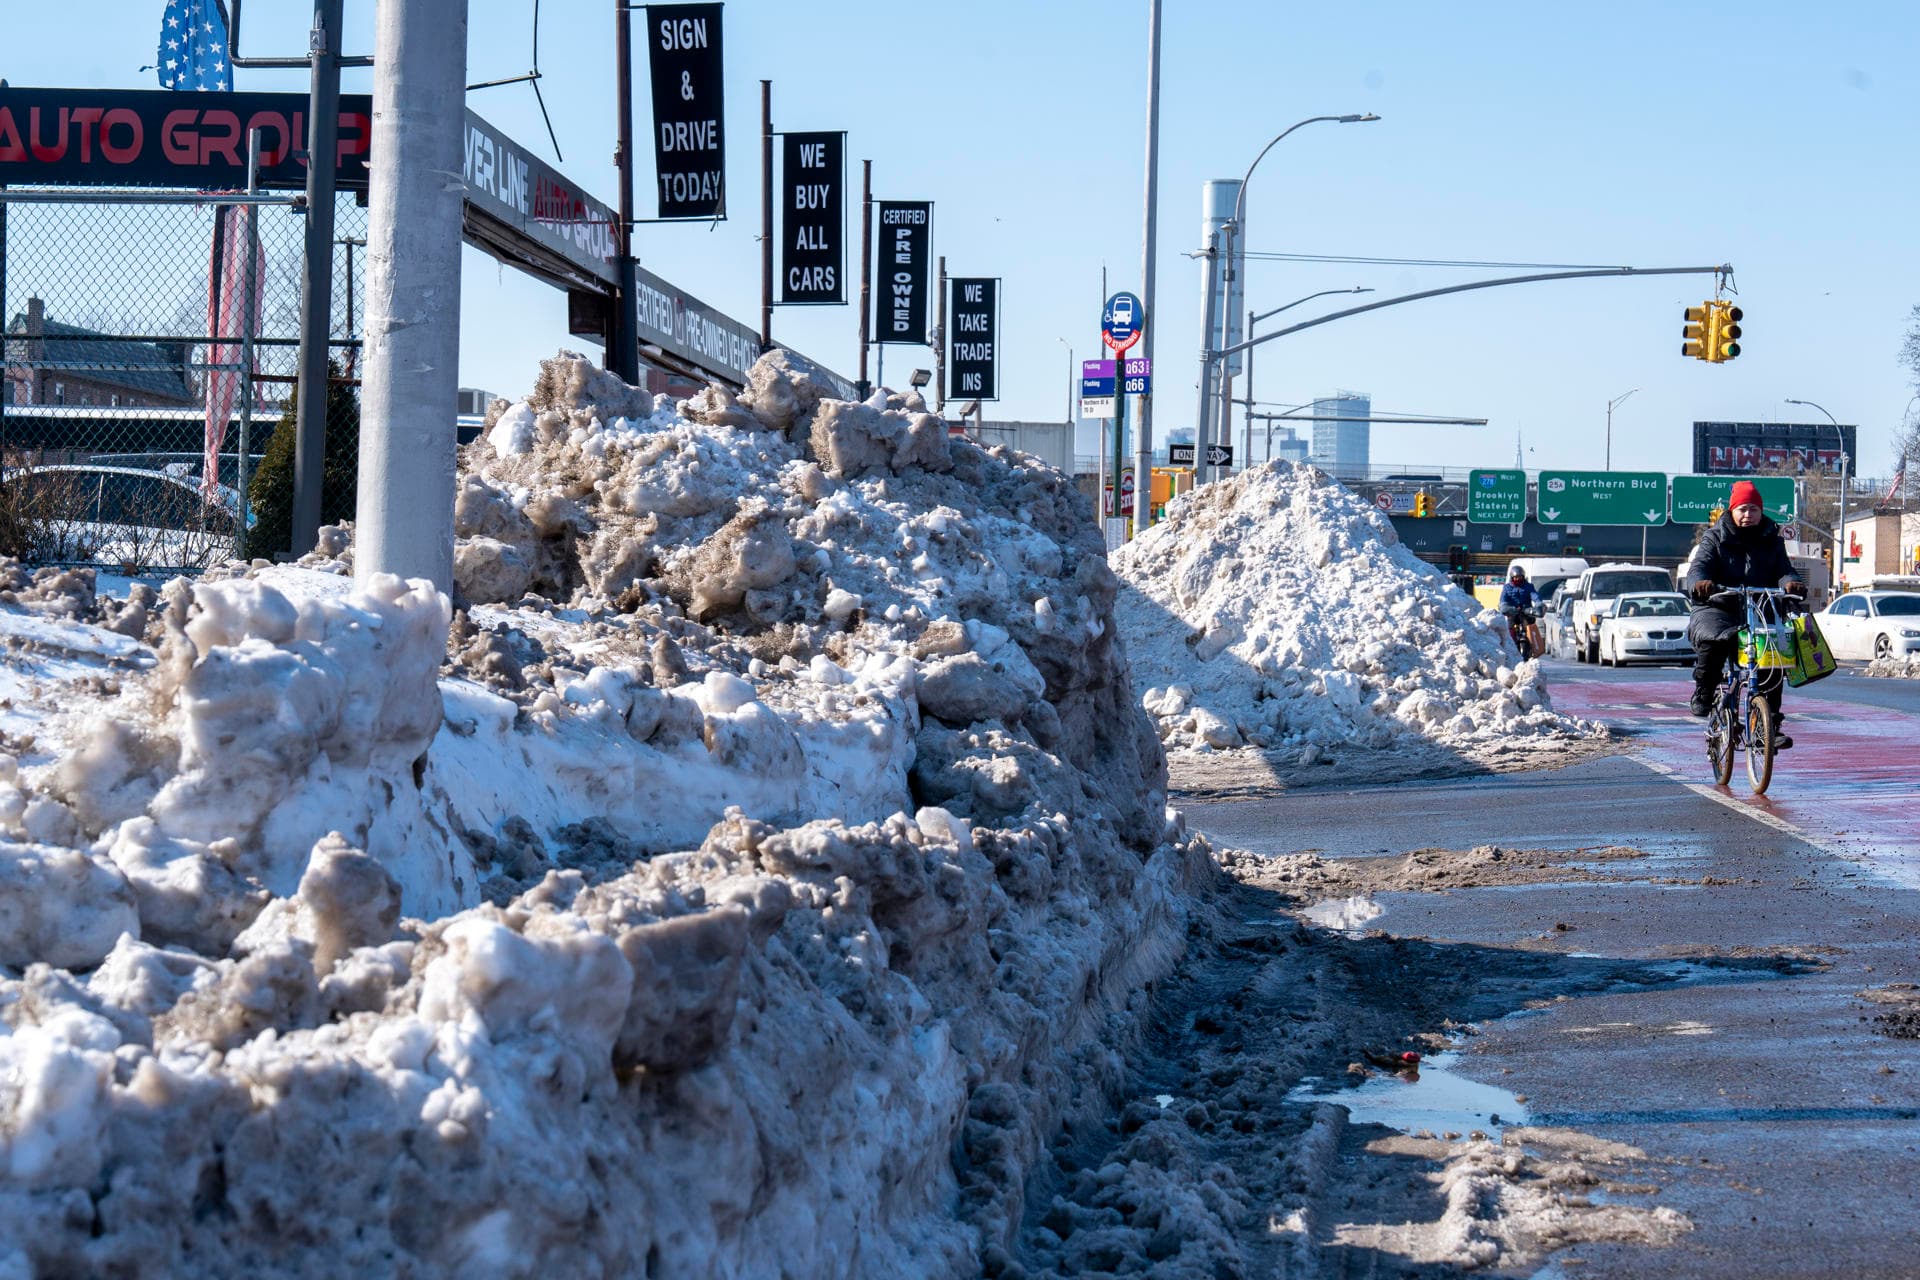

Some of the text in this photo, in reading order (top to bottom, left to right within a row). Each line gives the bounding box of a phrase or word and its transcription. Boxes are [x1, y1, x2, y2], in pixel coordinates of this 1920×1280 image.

[661, 18, 708, 50] SIGN
[681, 70, 695, 101] &
[0, 105, 144, 164] AUTO
[661, 120, 717, 152] DRIVE
[800, 143, 825, 168] WE
[498, 145, 529, 216] LINE
[533, 173, 571, 241] AUTO
[661, 170, 721, 202] TODAY
[796, 185, 829, 209] BUY
[883, 210, 926, 225] CERTIFIED
[796, 226, 828, 250] ALL
[789, 266, 835, 291] CARS
[893, 228, 913, 332] PRE OWNED
[965, 284, 983, 303] WE
[636, 281, 672, 336] ERTIFIED
[685, 308, 728, 365] PRE-OWNED
[959, 313, 987, 332] TAKE
[954, 343, 991, 361] TRADE
[1126, 361, 1145, 374] Q63
[963, 373, 982, 391] INS
[1125, 378, 1144, 392] Q66
[1475, 491, 1519, 500] Brooklyn
[1572, 479, 1625, 488] Northern
[1631, 480, 1657, 489] Blvd
[1511, 502, 1519, 510] Is
